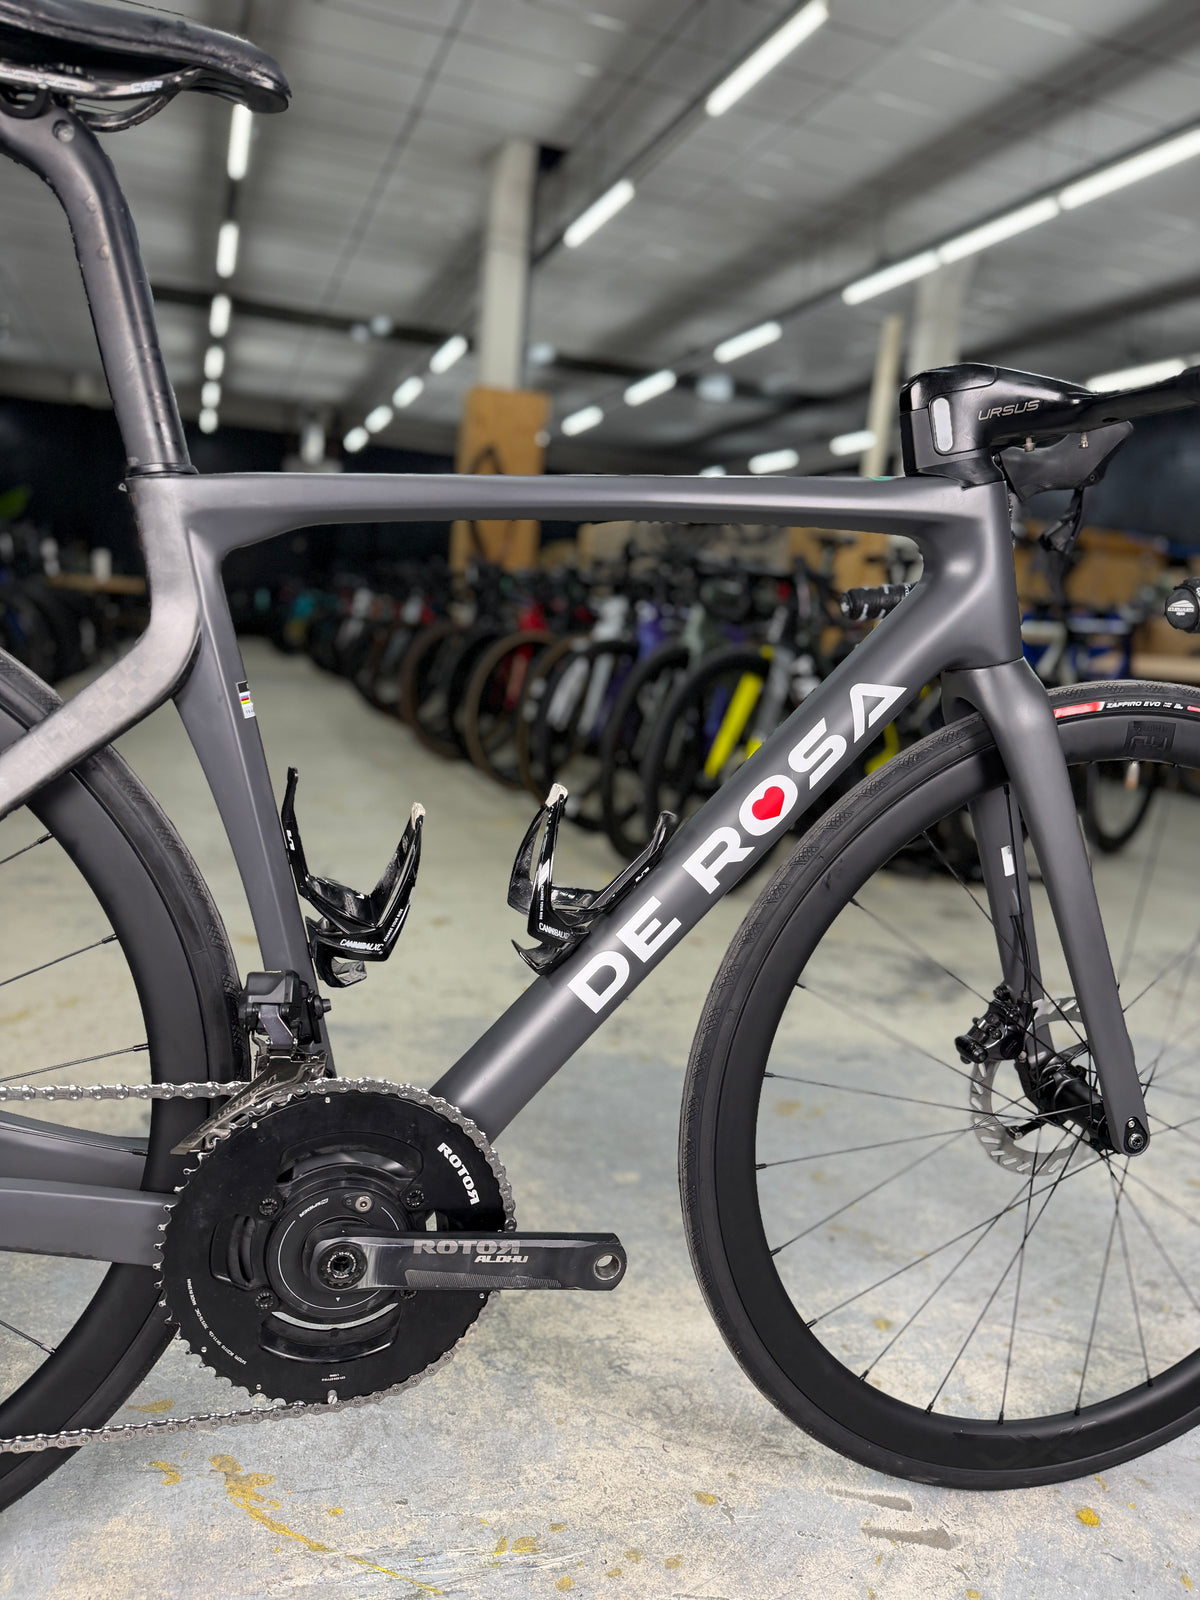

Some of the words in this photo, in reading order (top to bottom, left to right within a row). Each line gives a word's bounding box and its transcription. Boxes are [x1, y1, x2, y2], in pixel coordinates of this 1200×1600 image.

[978, 400, 1040, 420] URSUS
[567, 896, 682, 1013] DE
[682, 683, 907, 894] ROSA
[437, 1142, 480, 1205] ROTOR
[413, 1240, 520, 1254] ROTOR
